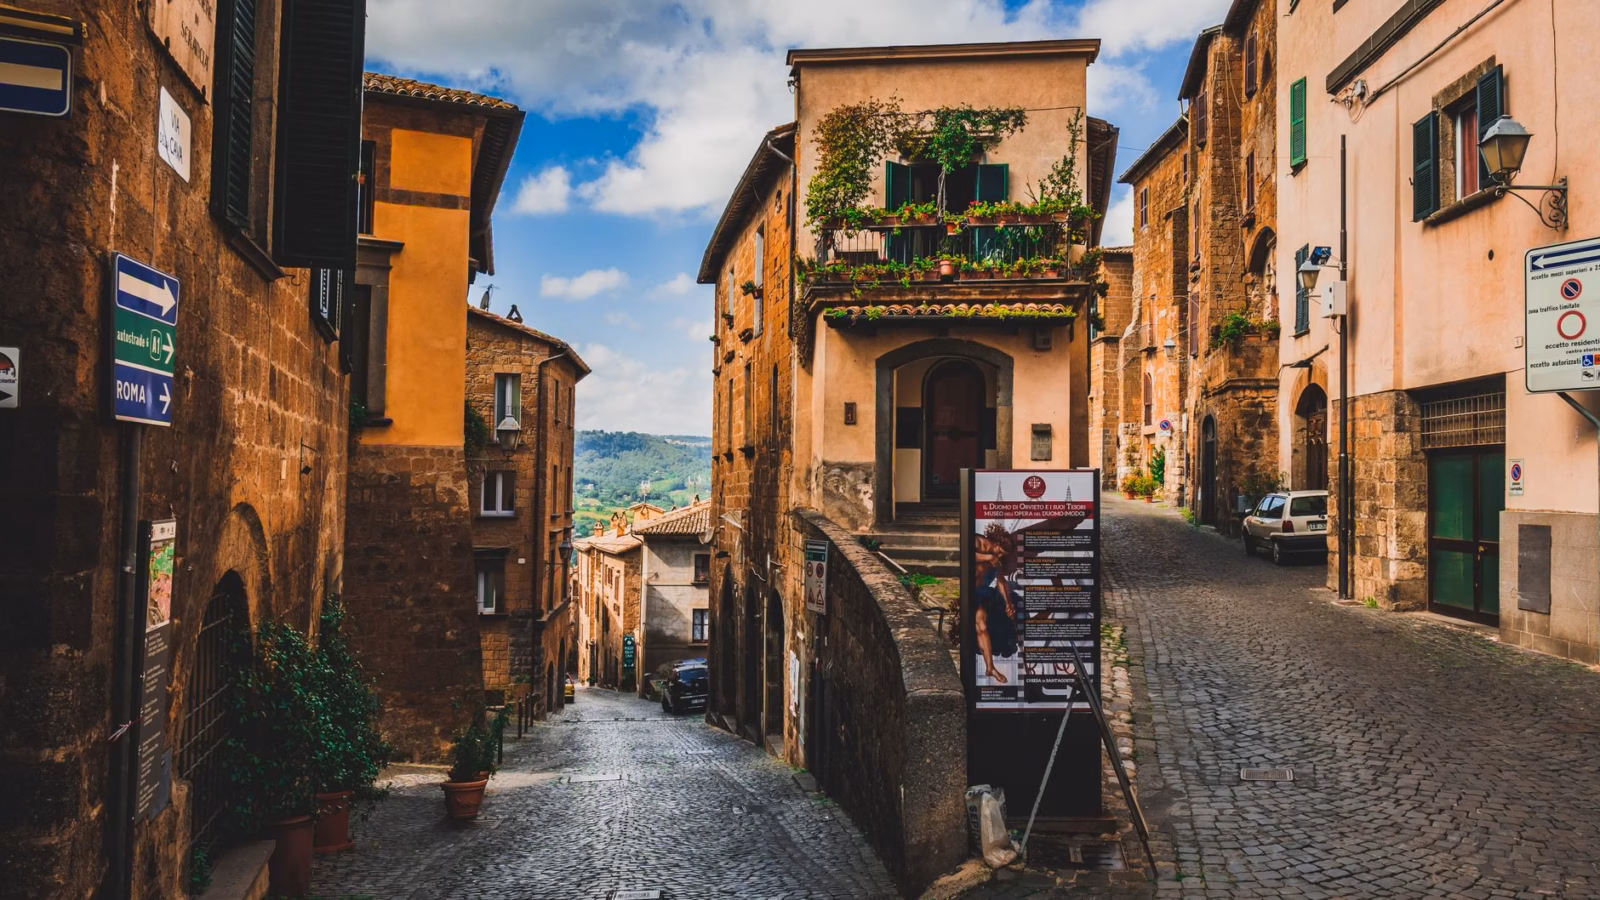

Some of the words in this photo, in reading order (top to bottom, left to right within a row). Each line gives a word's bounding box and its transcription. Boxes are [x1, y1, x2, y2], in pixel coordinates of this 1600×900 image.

[1531, 272, 1549, 281] eccetto
[1550, 270, 1564, 278] mezzi
[1565, 266, 1588, 276] superiori
[1540, 305, 1558, 313] traffico
[1559, 303, 1580, 311] limitato
[117, 329, 146, 348] autostrade
[152, 335, 160, 354] A1
[1545, 342, 1570, 350] eccetto
[1530, 361, 1550, 369] eccetto
[1551, 357, 1582, 367] autorizzati
[116, 380, 146, 404] ROMA
